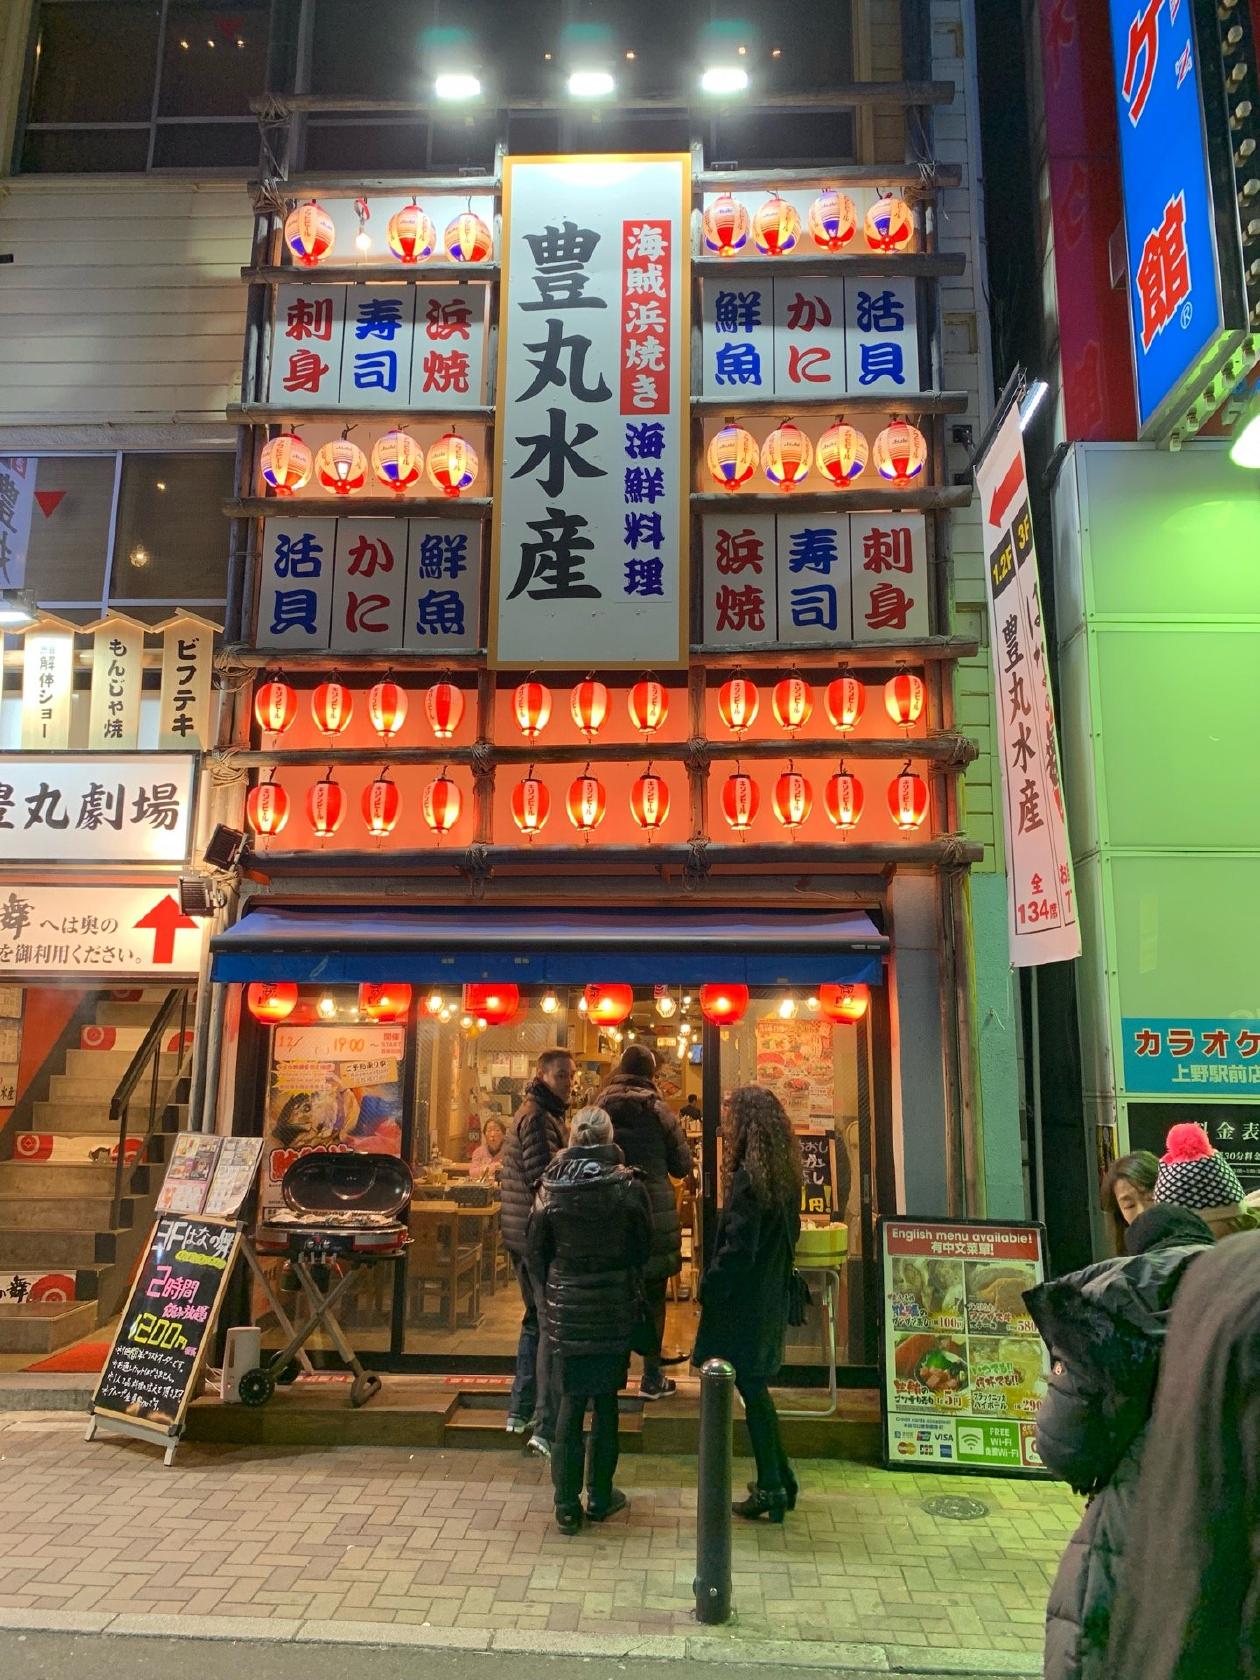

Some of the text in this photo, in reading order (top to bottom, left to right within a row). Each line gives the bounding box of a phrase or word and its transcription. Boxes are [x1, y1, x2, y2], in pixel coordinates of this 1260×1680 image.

[283, 298, 333, 393] 刺身
[354, 299, 402, 393] 寿司
[422, 299, 473, 393] 浜焼
[625, 224, 668, 409] 海賊浜焼き
[715, 291, 762, 385] 鮮魚
[787, 292, 832, 383] かに
[857, 291, 906, 385] 活貝
[506, 221, 613, 601] 豊丸水産
[624, 422, 666, 596] 海鮮料理
[1017, 514, 1030, 550] 3F
[270, 533, 323, 635] 活貝
[346, 535, 394, 633] かに
[416, 534, 467, 635] 鮮魚
[716, 528, 765, 631] 浜焼
[789, 528, 838, 631] 寿司
[863, 528, 915, 630] 刺身
[104, 639, 127, 739] もんじゃ焼
[172, 638, 199, 737] ビフテキ
[1003, 613, 1044, 836] 豊丸水産
[1017, 899, 1059, 925] 134席
[1031, 872, 1043, 895] 全
[1135, 1028, 1260, 1059] カラオケ
[1172, 1064, 1260, 1083] 上野駅前店
[892, 1228, 1032, 1244] English menu available!
[147, 1265, 201, 1303] 2時間
[162, 1302, 210, 1323] 飲み放題
[935, 1434, 953, 1442] VISA
[974, 1400, 1007, 1410] ハイボール
[990, 1428, 1010, 1436] FREE
